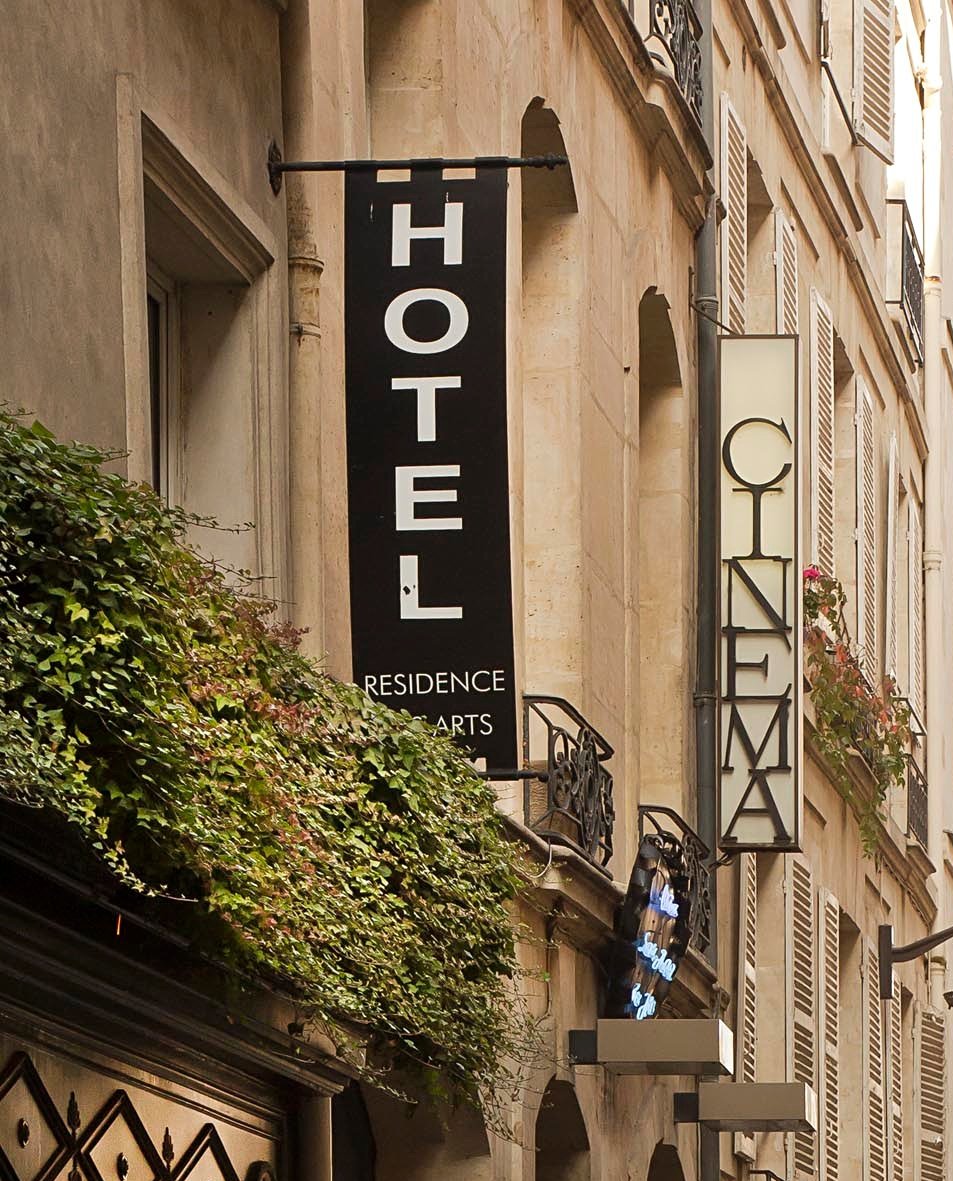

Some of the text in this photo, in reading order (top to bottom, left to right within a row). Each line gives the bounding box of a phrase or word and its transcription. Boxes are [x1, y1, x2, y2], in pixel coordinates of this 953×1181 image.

[384, 202, 469, 619] HOTEL
[364, 670, 505, 696] RESIDENCE
[433, 713, 493, 737] ARTS
[722, 417, 793, 844] CINEMA
